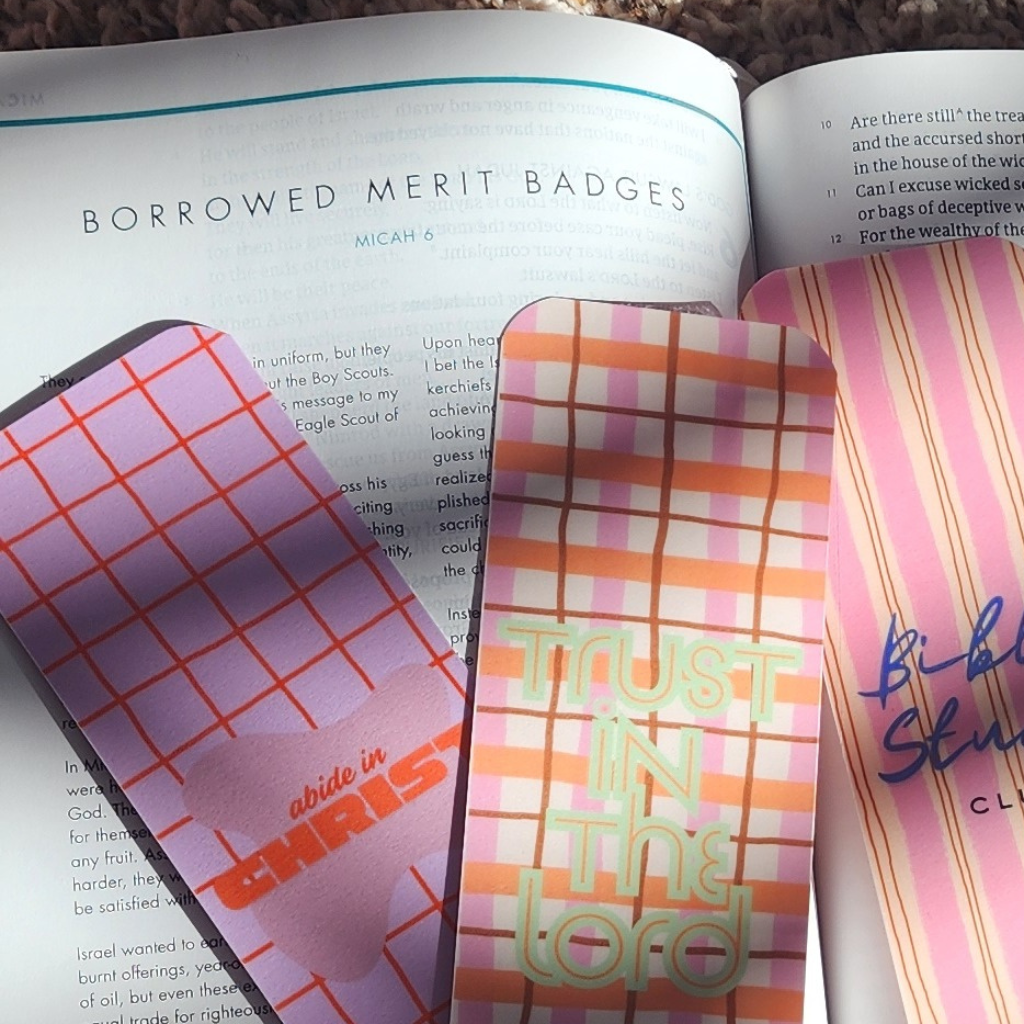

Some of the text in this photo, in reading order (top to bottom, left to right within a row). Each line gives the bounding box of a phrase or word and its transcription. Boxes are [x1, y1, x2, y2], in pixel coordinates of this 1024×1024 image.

[882, 110, 922, 125] there
[885, 133, 909, 147] the
[914, 130, 983, 145] accursed
[853, 161, 869, 175] in
[872, 158, 897, 172] the
[901, 155, 948, 169] house
[952, 153, 967, 167] of
[971, 153, 996, 167] the
[855, 184, 886, 197] Can
[898, 180, 951, 192] excuse
[954, 176, 1010, 190] wicked
[82, 170, 687, 233] BORROWED MERIT BADGES
[858, 208, 875, 221] or
[877, 204, 914, 220] bags
[918, 199, 934, 214] of
[937, 199, 1011, 217] deceptive
[354, 229, 414, 248] MICAH
[859, 229, 886, 244] For
[889, 225, 915, 240] the
[918, 221, 980, 240] wealthy
[985, 222, 1001, 236] of
[422, 336, 462, 353] Upon
[252, 343, 390, 368] in uniform, but they
[434, 357, 456, 371] bet
[462, 355, 483, 369] the
[285, 372, 306, 387] the
[312, 371, 338, 386] Boy
[343, 366, 393, 380] Scouts.
[426, 376, 492, 396] kerchiefs
[292, 394, 353, 410] message
[359, 390, 372, 402] to
[377, 389, 398, 402] my
[295, 406, 398, 434] Eagle Scout of
[430, 424, 485, 440] looking
[432, 450, 474, 467] guess
[366, 476, 387, 490] his
[442, 538, 482, 553] could
[443, 562, 465, 576] the
[65, 760, 78, 773] In
[66, 784, 103, 796] were
[290, 748, 386, 820] abide in
[67, 803, 106, 820] God.
[70, 829, 89, 843] for
[71, 857, 98, 870] any
[104, 850, 137, 864] fruit.
[72, 874, 126, 891] harder,
[133, 867, 164, 886] they
[74, 893, 159, 915] be satisfied
[77, 937, 194, 960] Israel wanted to
[78, 964, 189, 984] burnt offerings,
[79, 992, 94, 1008] of
[100, 990, 123, 1007] oil,
[129, 988, 152, 1003] but
[158, 988, 193, 1001] even
[199, 980, 237, 997] these
[174, 1008, 195, 1023] for
